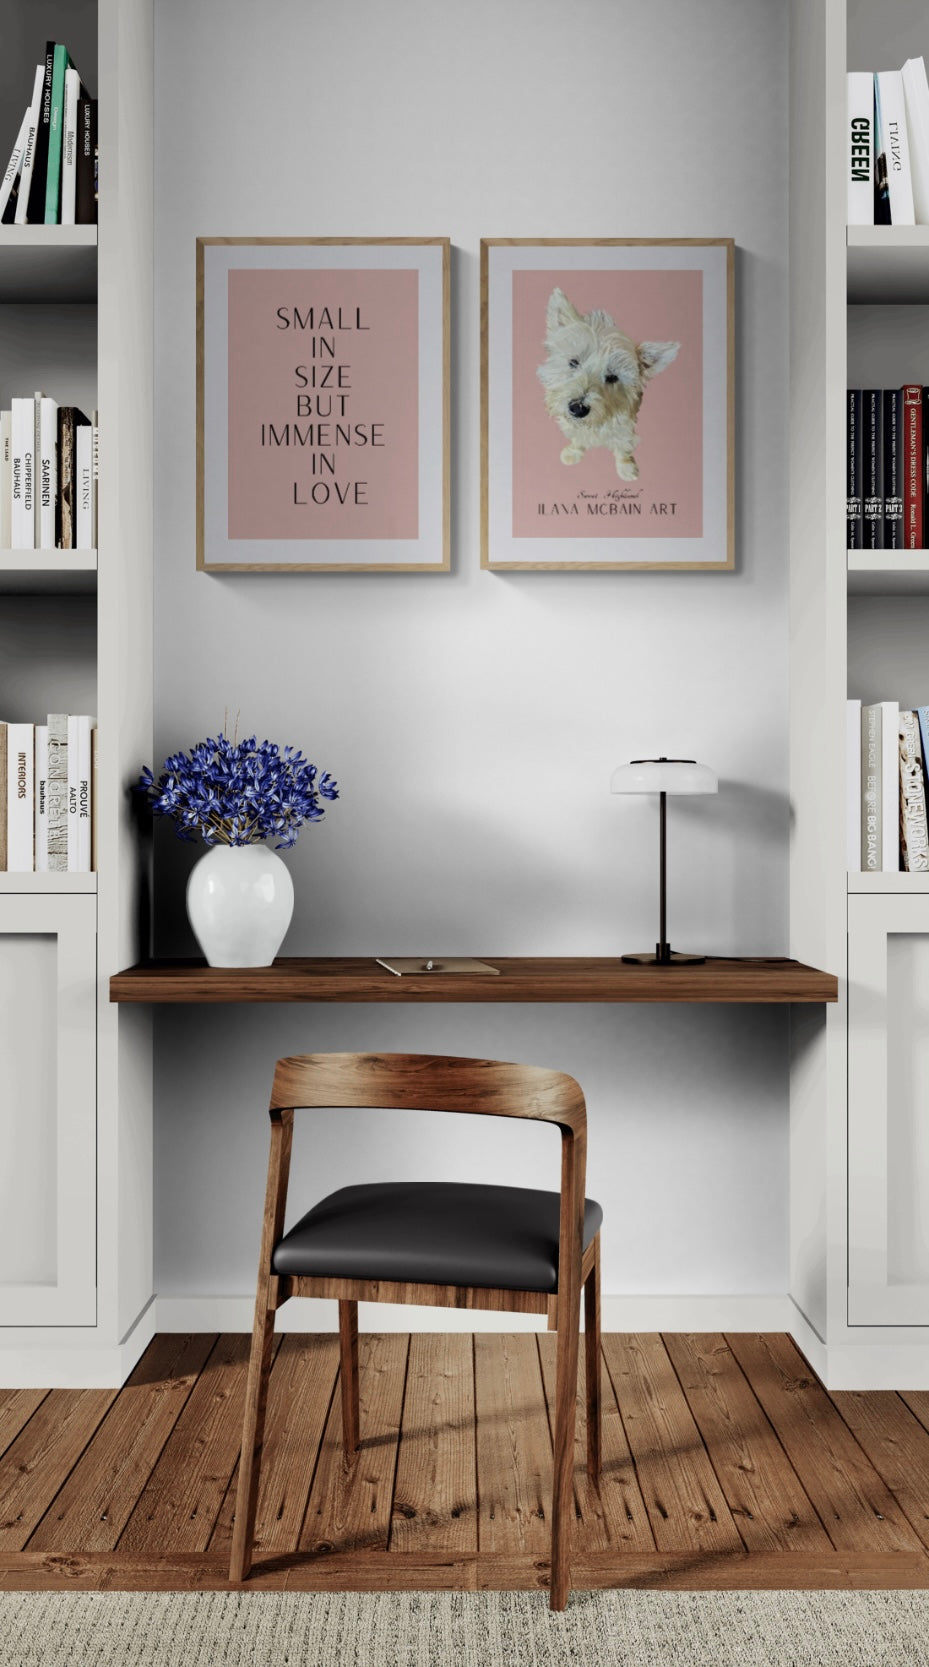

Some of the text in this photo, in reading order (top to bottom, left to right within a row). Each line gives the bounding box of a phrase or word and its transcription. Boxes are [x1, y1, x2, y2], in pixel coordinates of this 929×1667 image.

[43, 88, 51, 123] HOUSES
[24, 127, 35, 168] BAUHAUS
[5, 149, 21, 181] LIVING
[276, 307, 370, 330] SMALL
[312, 336, 335, 358] IN
[295, 365, 352, 388] SIZE
[297, 395, 349, 417] BUT
[261, 424, 385, 446] IMMENSE
[312, 453, 335, 475] IN
[42, 459, 50, 507] SAARINEN
[294, 482, 368, 505] LOVE
[538, 503, 678, 515] ILANA MCBAIN ART
[858, 504, 861, 513] 1
[18, 752, 26, 799] INTERIORS
[80, 781, 90, 818] PROUVÉ
[867, 816, 876, 833] BIG
[904, 763, 928, 869] STONEWORKS
